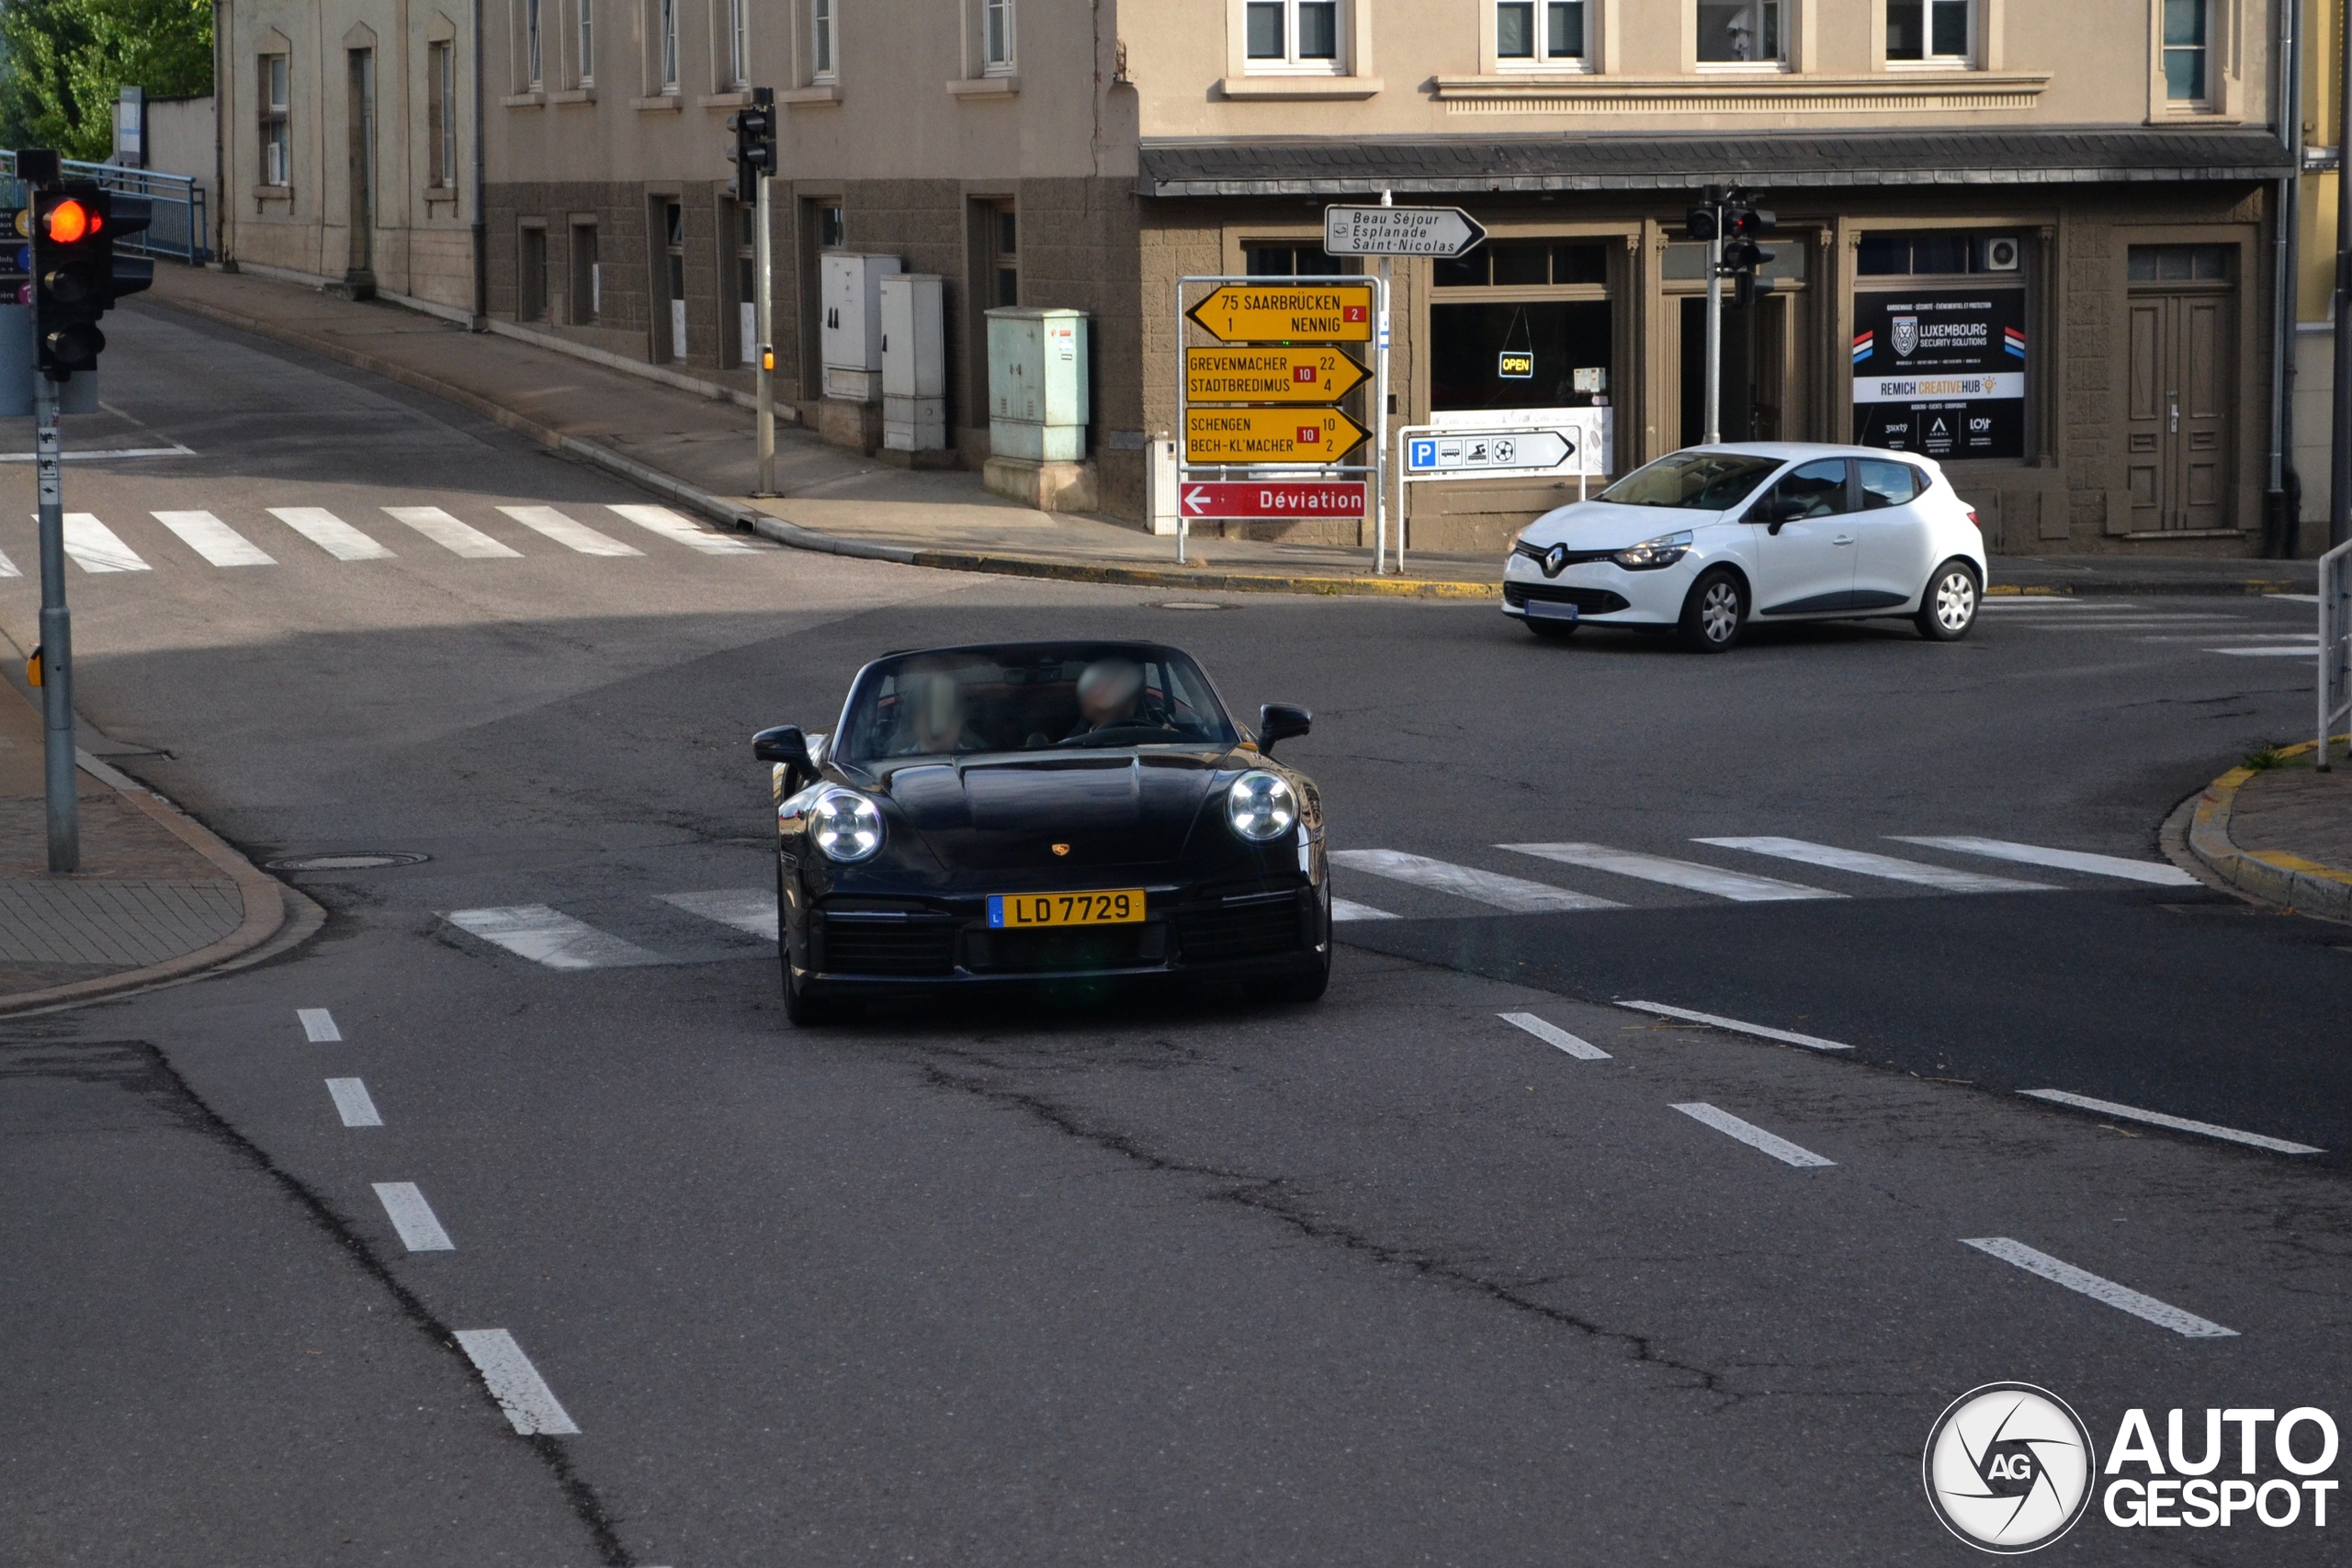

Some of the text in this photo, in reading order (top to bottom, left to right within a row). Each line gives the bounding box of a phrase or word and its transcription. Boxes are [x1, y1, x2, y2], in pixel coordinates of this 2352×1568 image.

[1352, 212, 1440, 226] Beau Séjour
[1352, 225, 1427, 239] Esplanade
[1352, 238, 1454, 252] Saint-Nicolas
[1221, 291, 1340, 310] 75 SAARBRÜCKEN
[1351, 309, 1359, 321] 2
[1227, 317, 1340, 332] 1 NENNIG
[1920, 323, 1987, 337] LUXEMBOURG
[1920, 337, 1987, 347] SECURITY SOLUTIONS
[1190, 356, 1335, 370] GREVENMACHER 22
[1502, 358, 1530, 371] OPEN
[1299, 368, 1311, 380] 10
[1190, 378, 1331, 391] STADTBREDIMUS 4
[1881, 379, 1981, 396] REMICH CREATIVEHUB
[1191, 418, 1335, 431] SCHENGEN 10
[1303, 429, 1314, 442] 10
[1191, 439, 1333, 452] BECH-KL'MACHER 2
[1418, 444, 1431, 464] P
[1260, 490, 1362, 508] Déviation
[992, 894, 1130, 923] L LD 7729
